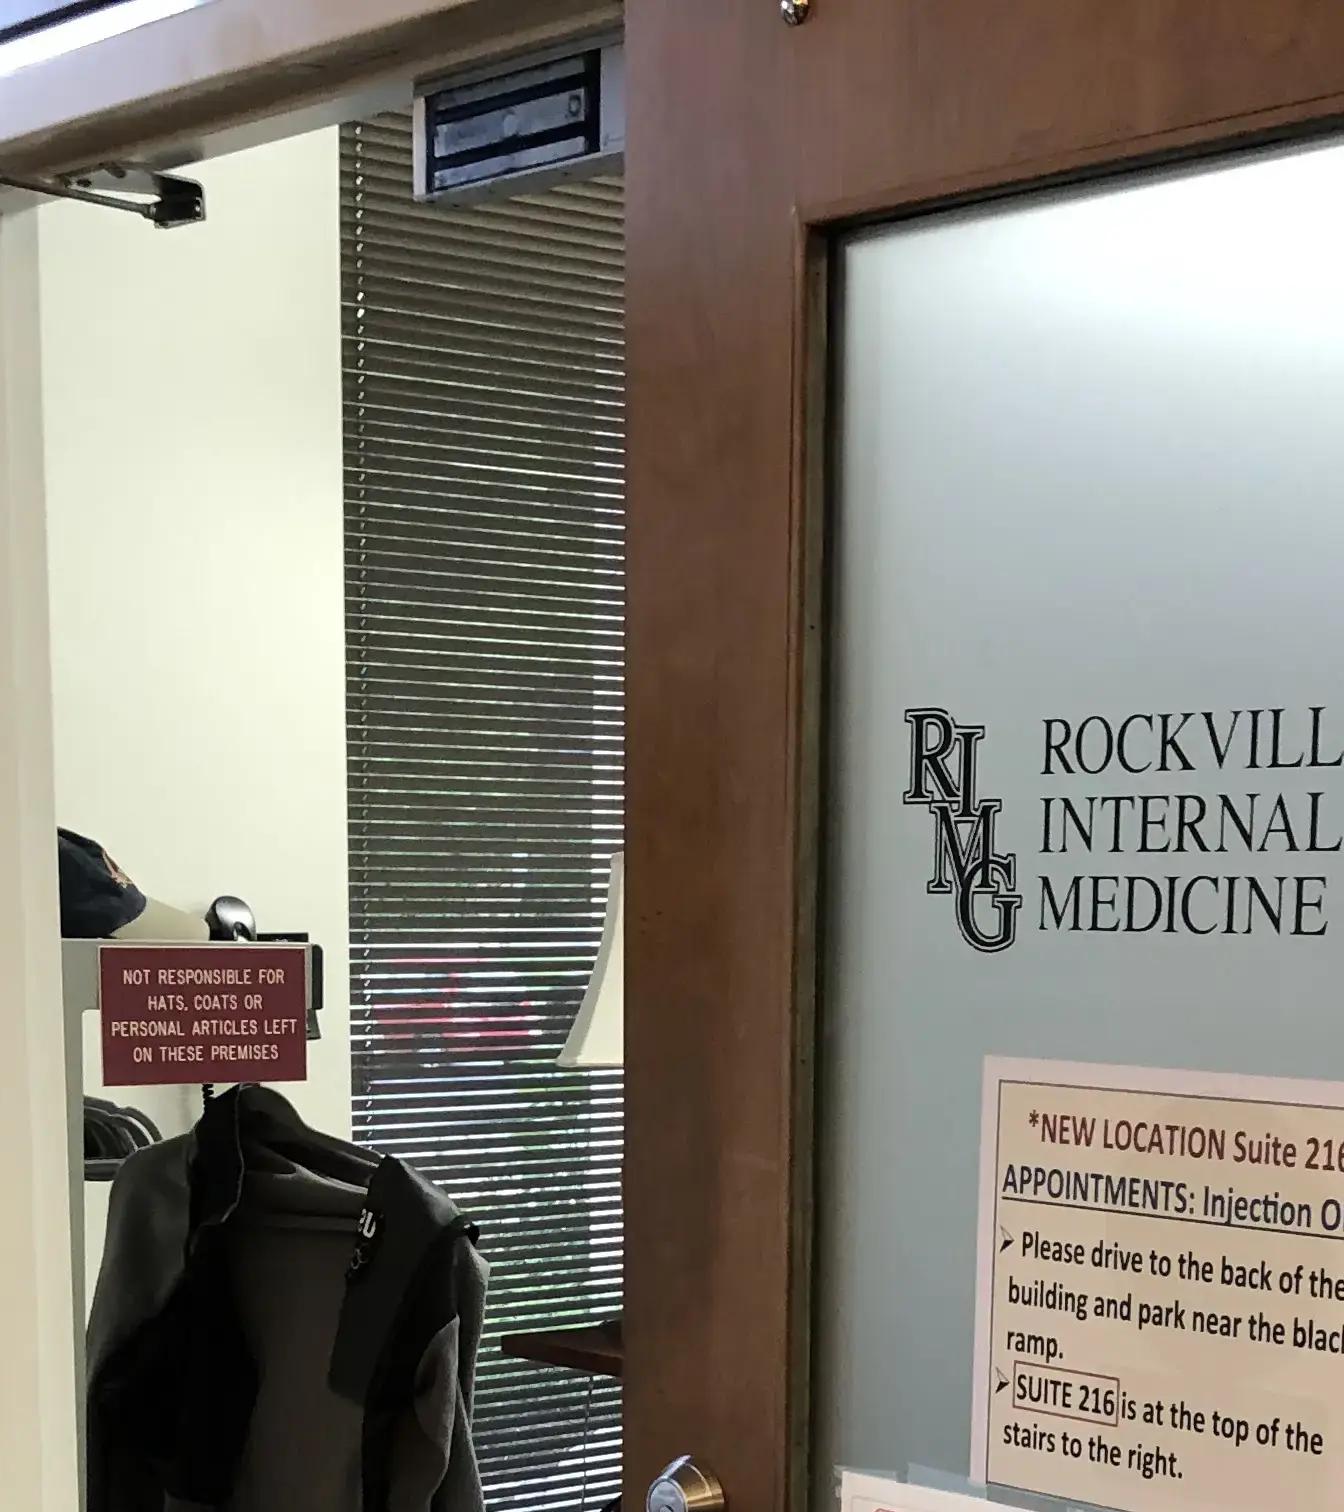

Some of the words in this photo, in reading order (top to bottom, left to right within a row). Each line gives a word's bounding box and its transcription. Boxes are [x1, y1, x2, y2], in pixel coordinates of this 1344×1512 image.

[1038, 791, 1344, 855] INTERNAL
[1038, 875, 1329, 937] MEDICINE
[123, 968, 151, 985] NOT
[158, 968, 252, 985] RESPONSIBLE
[259, 968, 285, 984] FOR
[194, 994, 238, 1011] COATS
[244, 994, 263, 1010] OR
[111, 1020, 185, 1037] PERSONAL
[191, 1019, 257, 1036] ARTICLES
[264, 1018, 298, 1035] LEFT
[133, 1046, 153, 1063] ON
[159, 1045, 204, 1062] THESE
[211, 1044, 279, 1061] PREMISES
[1103, 1117, 1226, 1161] LOCATION
[1232, 1129, 1298, 1168] Suite
[1002, 1164, 1195, 1216] APPOINTMENTS:
[1203, 1185, 1312, 1229] Injection
[1021, 1230, 1085, 1265] Please
[1090, 1239, 1143, 1273] drive
[1149, 1249, 1172, 1277] to
[1177, 1251, 1214, 1284] the
[1220, 1255, 1273, 1292] back
[1279, 1265, 1304, 1293] of
[1008, 1275, 1087, 1321] building
[1093, 1293, 1132, 1322] and
[1138, 1300, 1186, 1331] park
[1192, 1310, 1242, 1339] near
[1248, 1313, 1286, 1346] the
[1006, 1332, 1064, 1363] ramp.
[1016, 1373, 1073, 1409] SUITE
[1078, 1384, 1115, 1417] 216
[1121, 1392, 1138, 1421] is
[1142, 1397, 1164, 1426] at
[1170, 1402, 1206, 1434] the
[1211, 1411, 1249, 1446] top
[1256, 1418, 1282, 1448] of
[1285, 1421, 1324, 1456] the
[1002, 1421, 1056, 1453] stairs
[1061, 1431, 1083, 1459] to
[1088, 1434, 1122, 1467] the
[1127, 1443, 1184, 1480] right.
